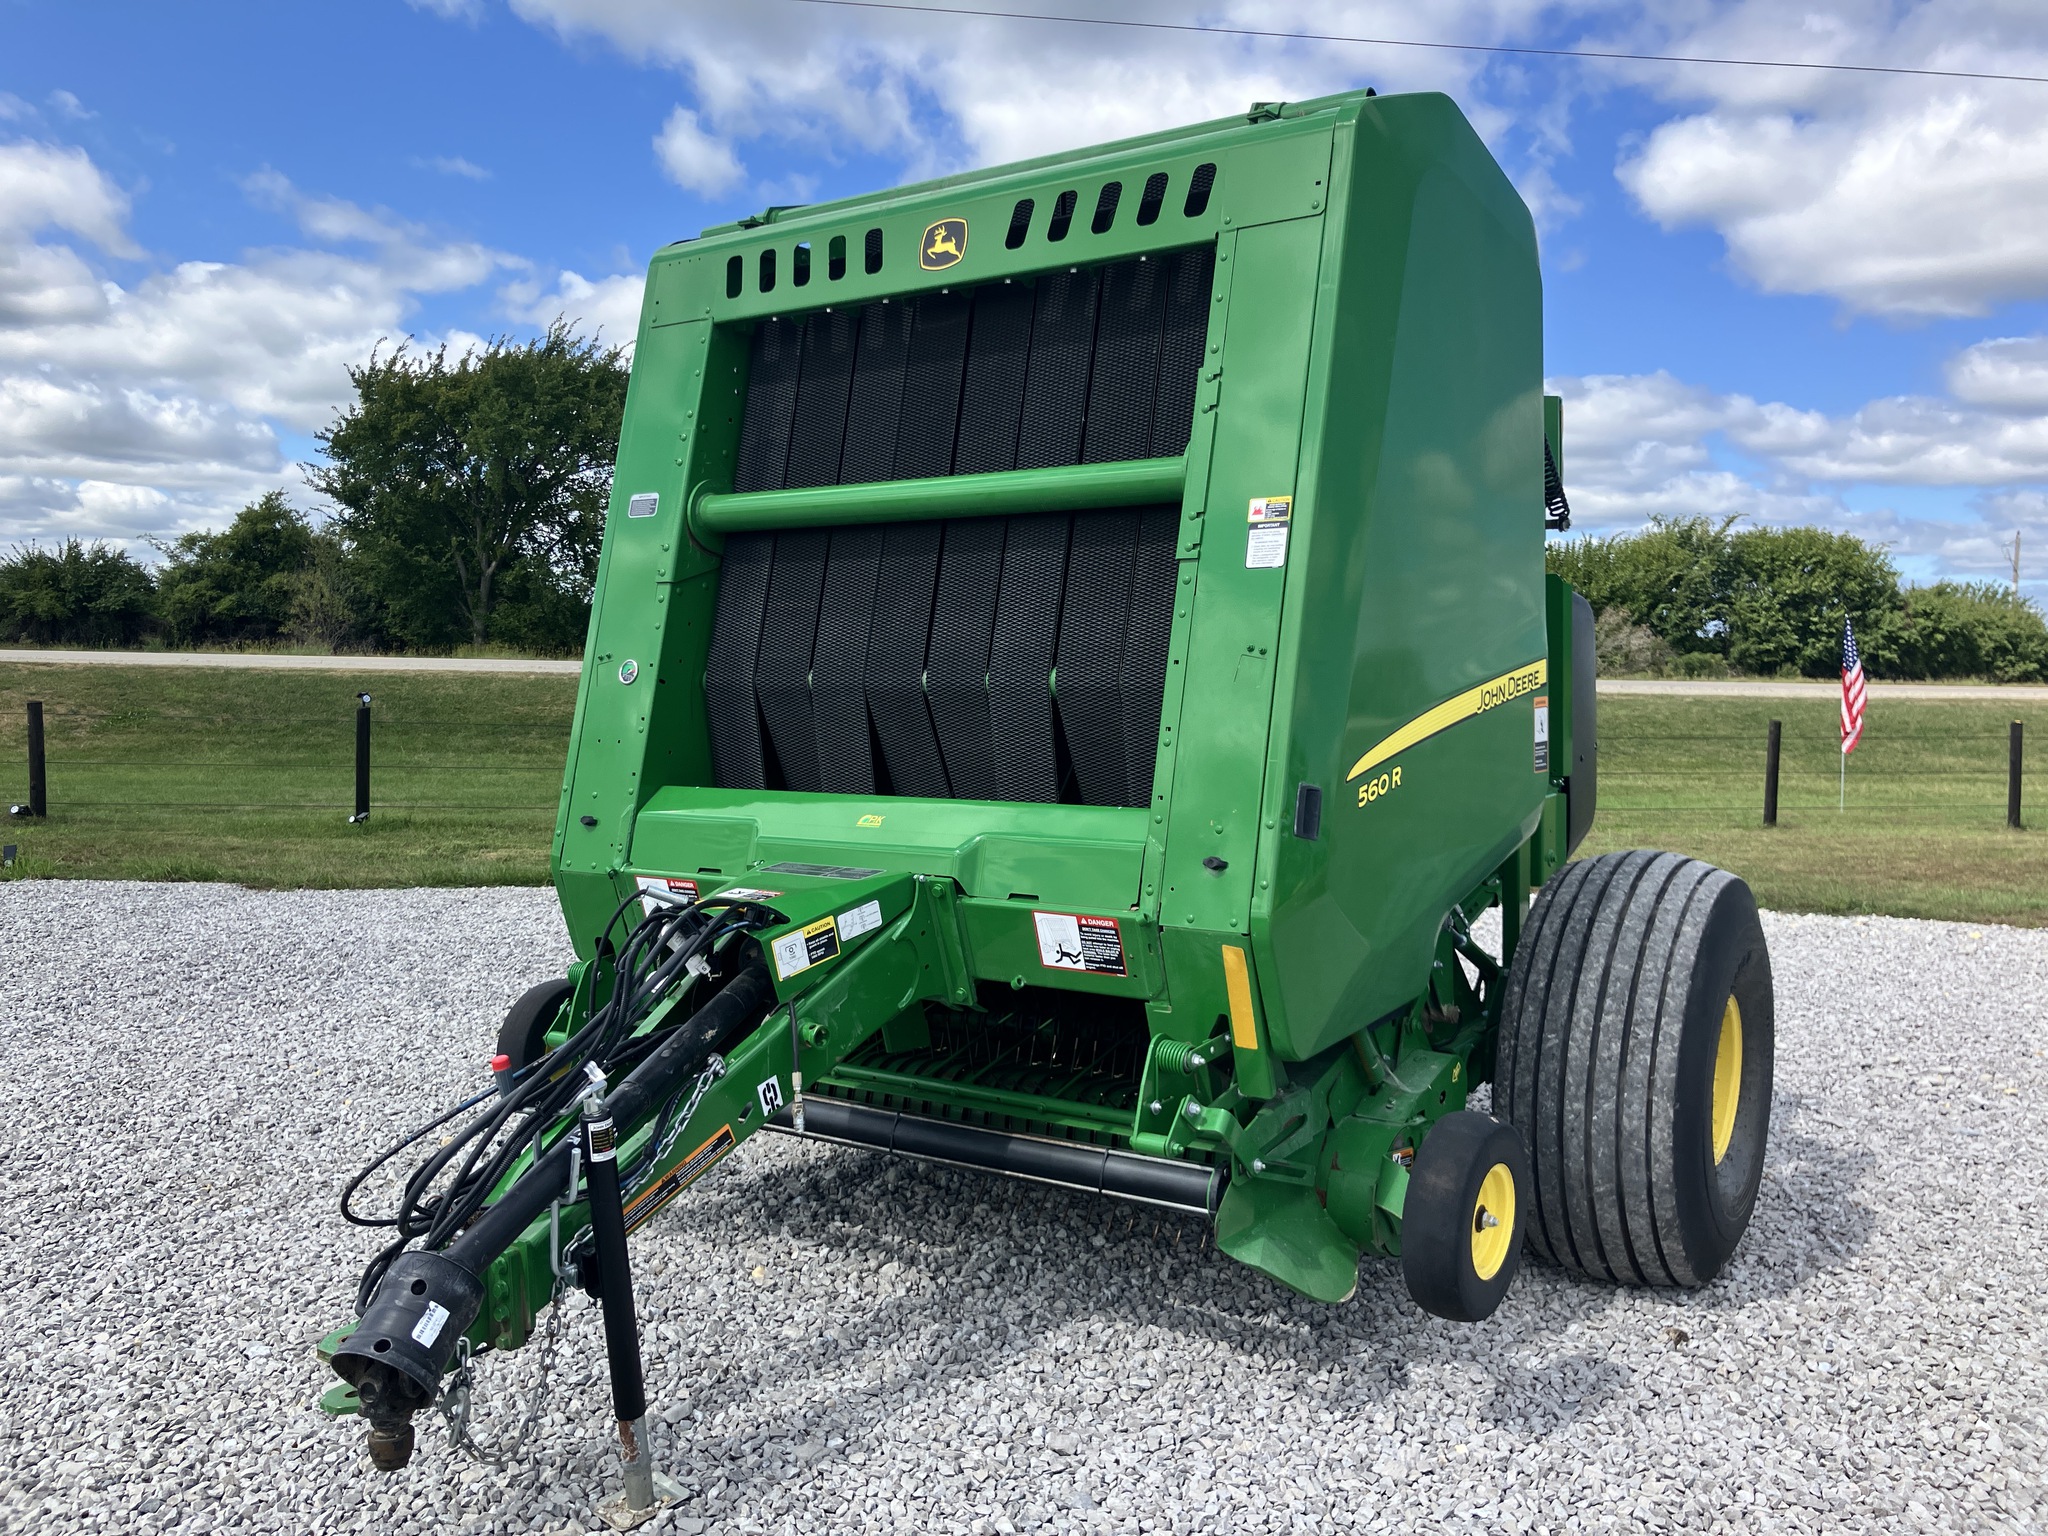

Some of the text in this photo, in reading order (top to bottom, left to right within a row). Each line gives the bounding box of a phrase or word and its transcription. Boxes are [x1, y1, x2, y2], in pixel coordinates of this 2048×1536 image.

[1477, 670, 1540, 711] JOHN DEERE
[1358, 766, 1402, 808] 560 R
[811, 921, 831, 934] CAUTION
[1088, 919, 1114, 927] DANGER
[664, 1160, 687, 1180] WARNING
